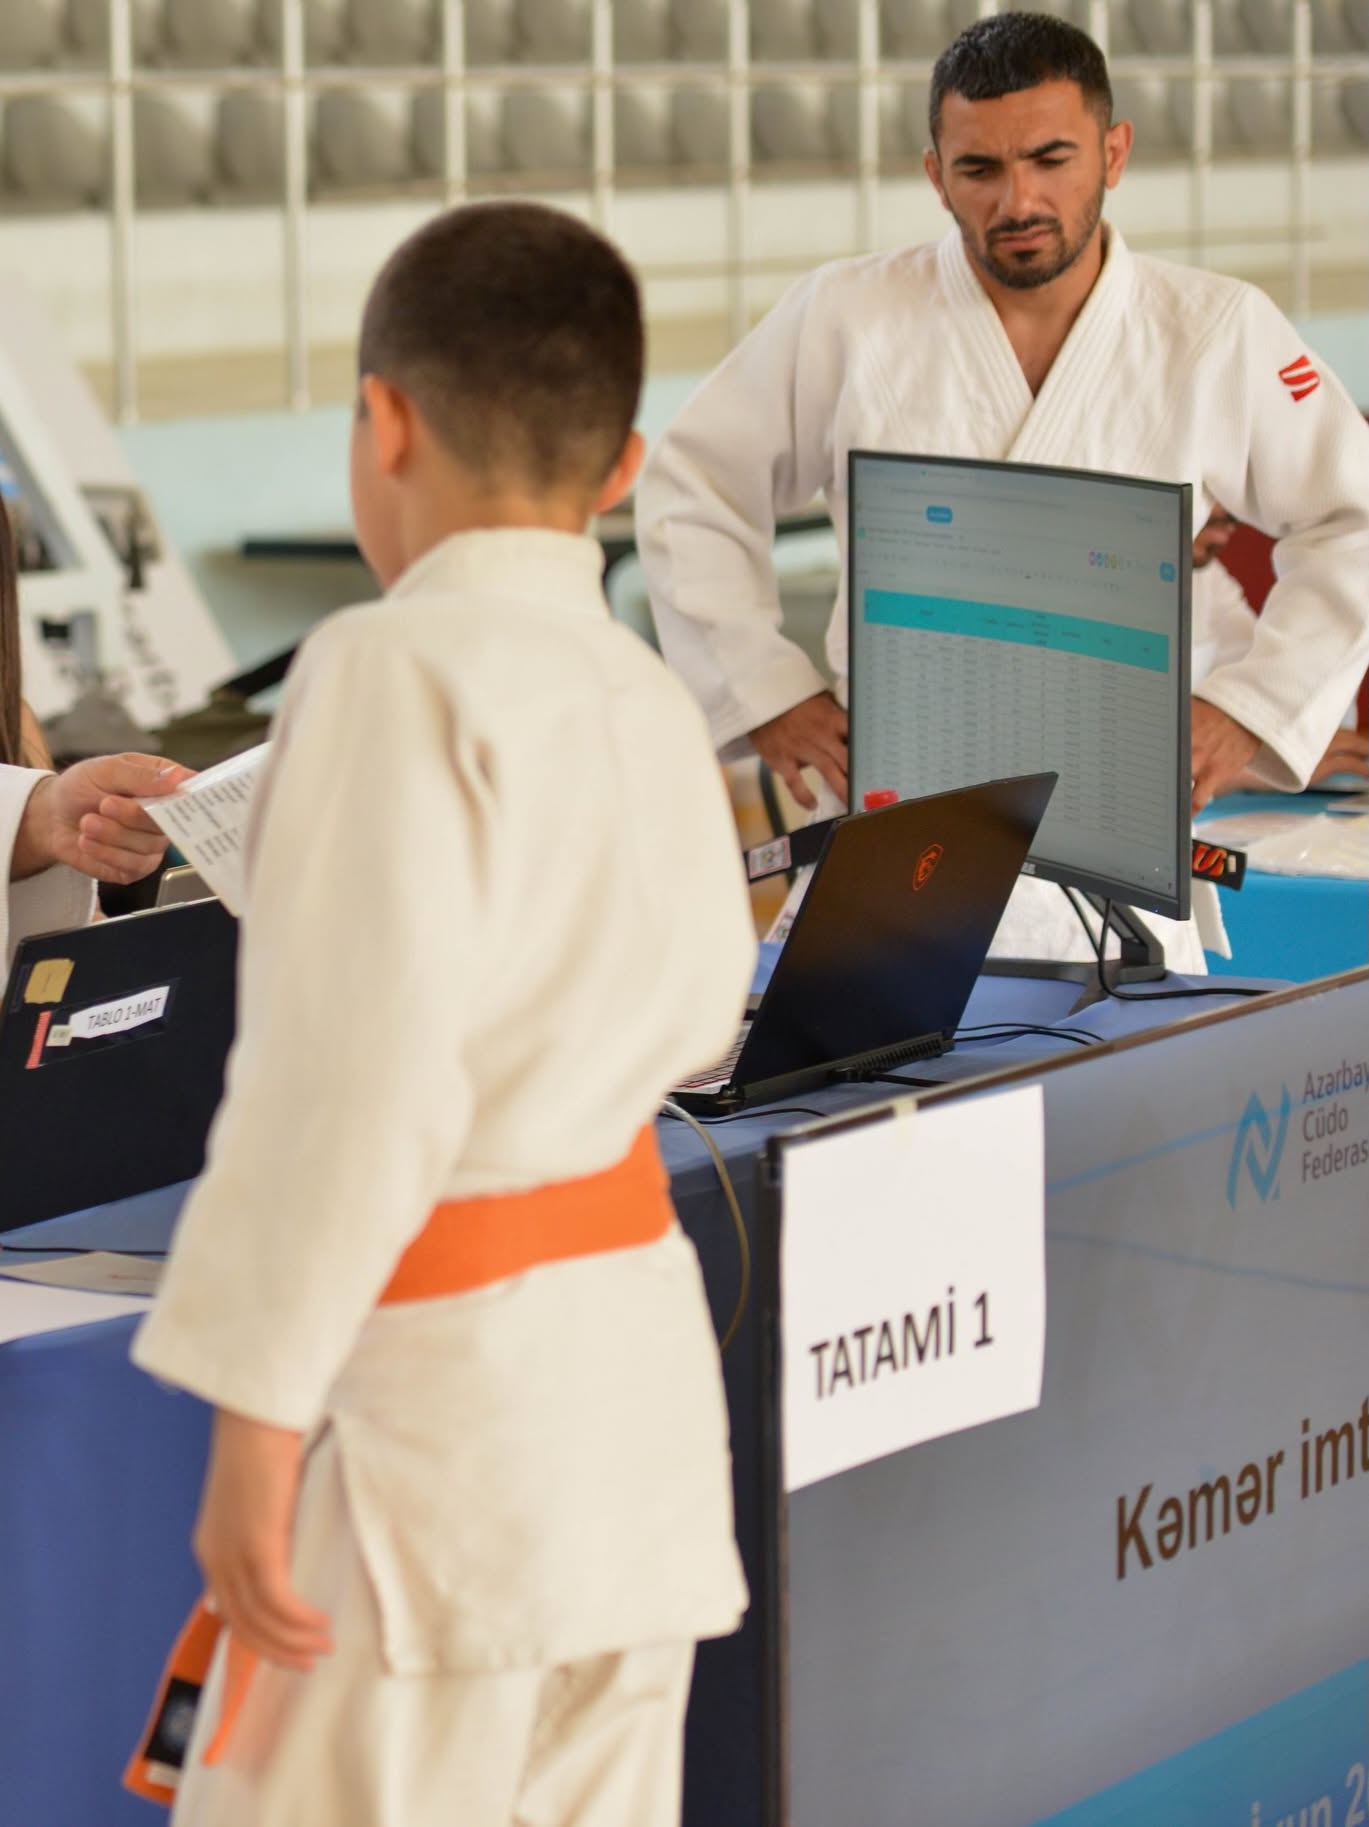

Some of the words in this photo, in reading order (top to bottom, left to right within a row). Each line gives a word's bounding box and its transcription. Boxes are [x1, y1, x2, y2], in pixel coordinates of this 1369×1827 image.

[88, 1008, 122, 1030] TABLO
[125, 997, 161, 1021] 1-MAT
[1302, 1102, 1349, 1142] Cüdo
[1301, 1139, 1369, 1184] Federas
[809, 1284, 956, 1401] TATAMİ
[973, 1291, 995, 1349] 1
[1116, 1449, 1285, 1581] Kəmər
